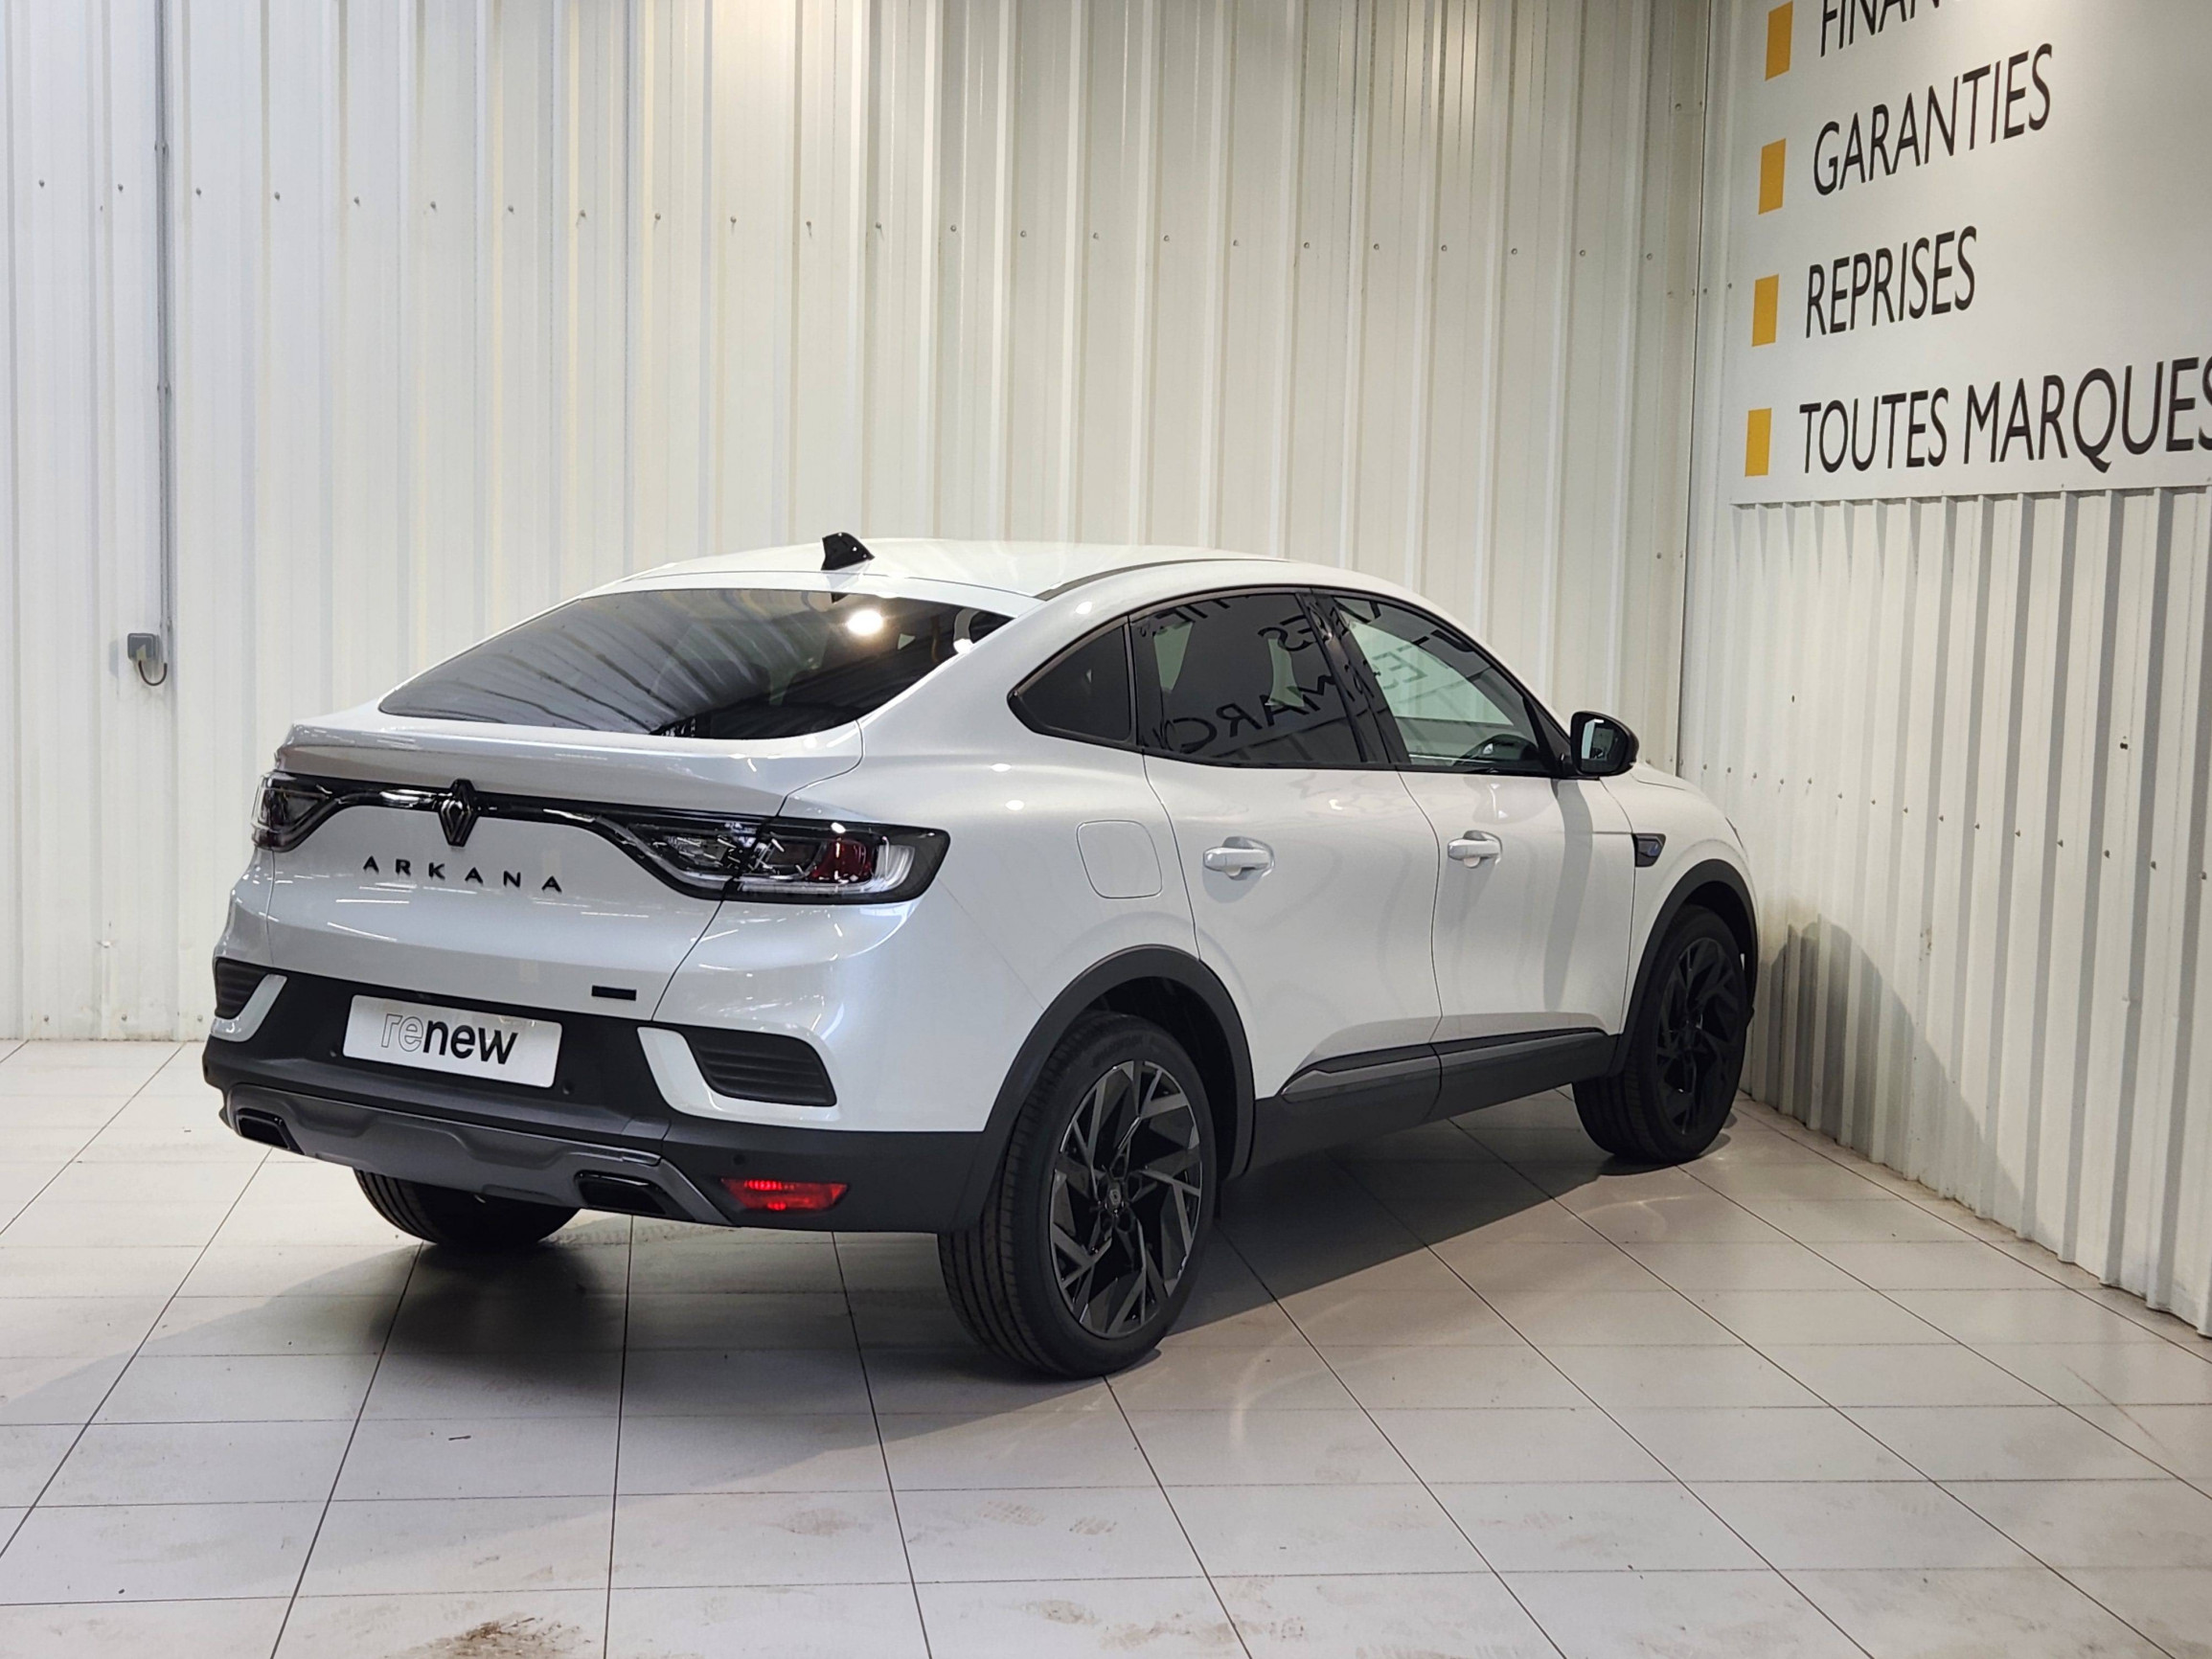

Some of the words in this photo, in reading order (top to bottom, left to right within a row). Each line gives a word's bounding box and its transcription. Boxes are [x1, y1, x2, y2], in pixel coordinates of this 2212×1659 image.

[1820, 0, 1940, 57] FIN
[1813, 43, 2053, 195] GARANTIES
[1806, 225, 1977, 338] REPRISES
[1799, 387, 1949, 473] TOUTES
[363, 855, 562, 893] ARKANA
[381, 1012, 518, 1065] renew
